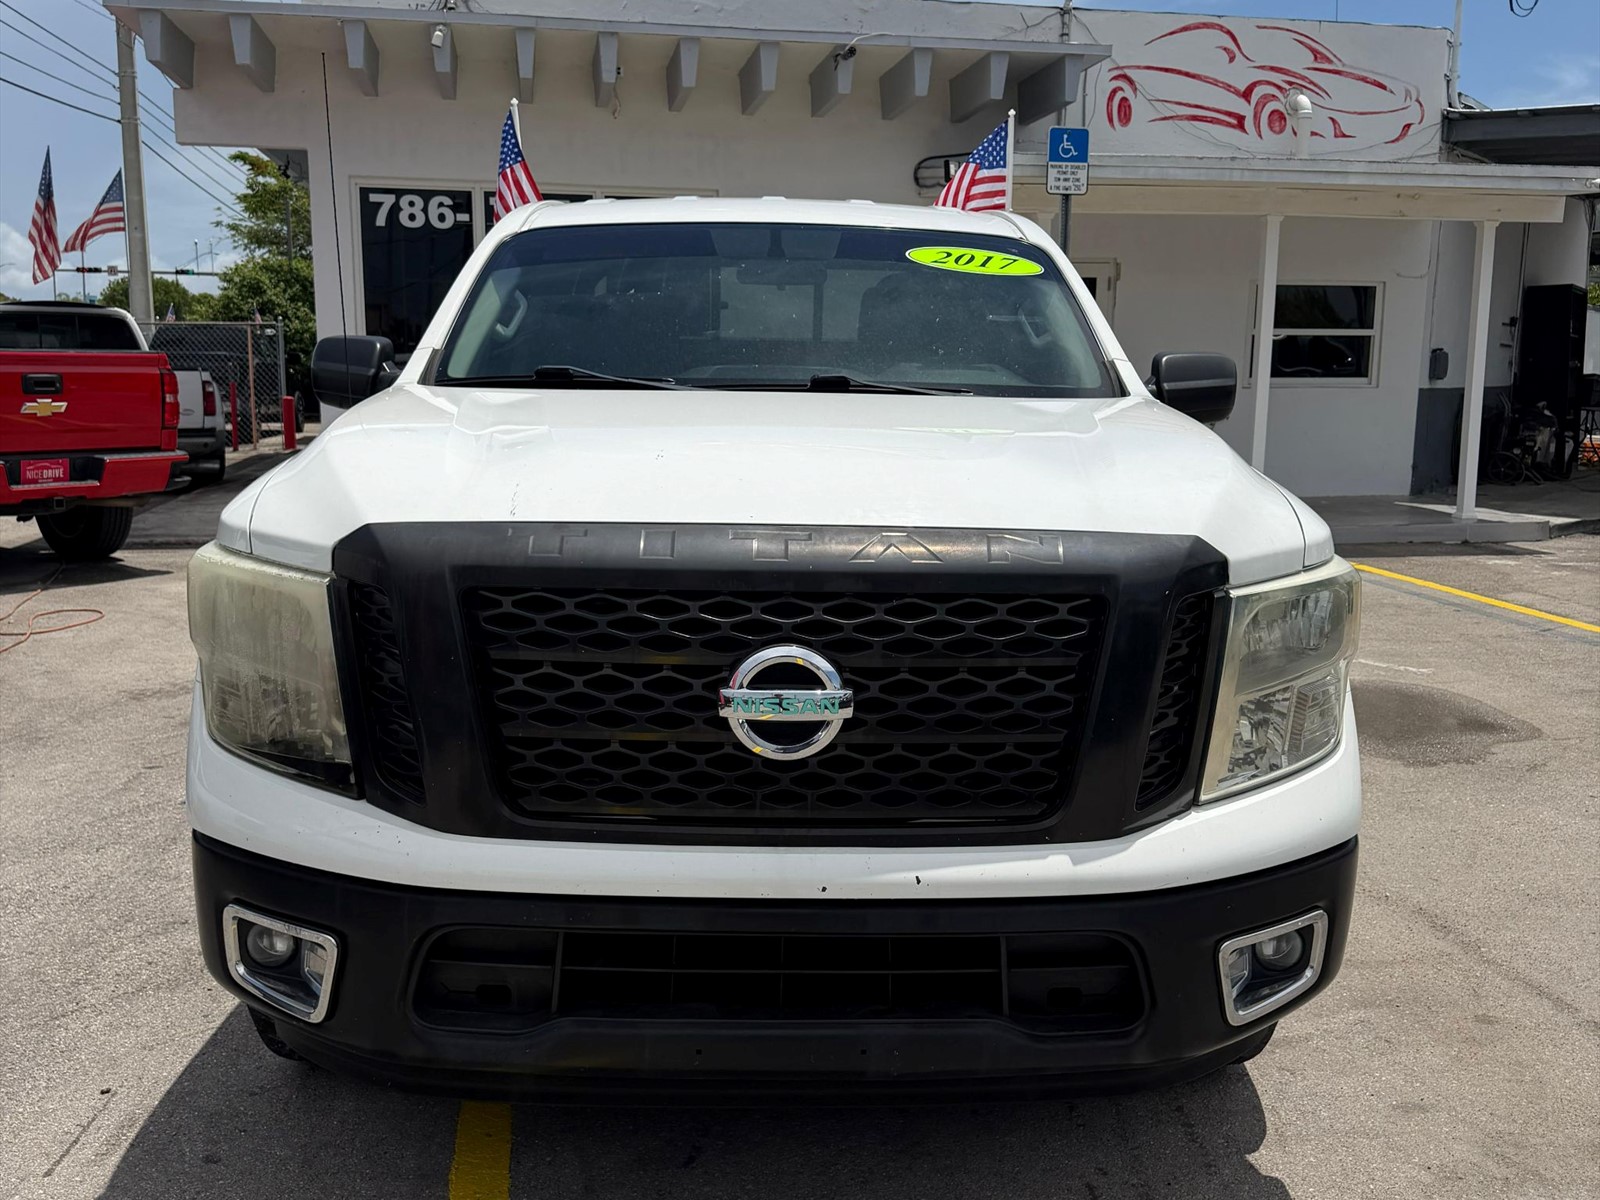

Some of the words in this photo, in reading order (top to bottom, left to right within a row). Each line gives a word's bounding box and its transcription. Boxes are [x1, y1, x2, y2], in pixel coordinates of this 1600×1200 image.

[368, 193, 471, 230] 786-
[930, 251, 1020, 270] 2017
[507, 526, 1065, 565] TITAN
[732, 697, 841, 715] NISSAN
